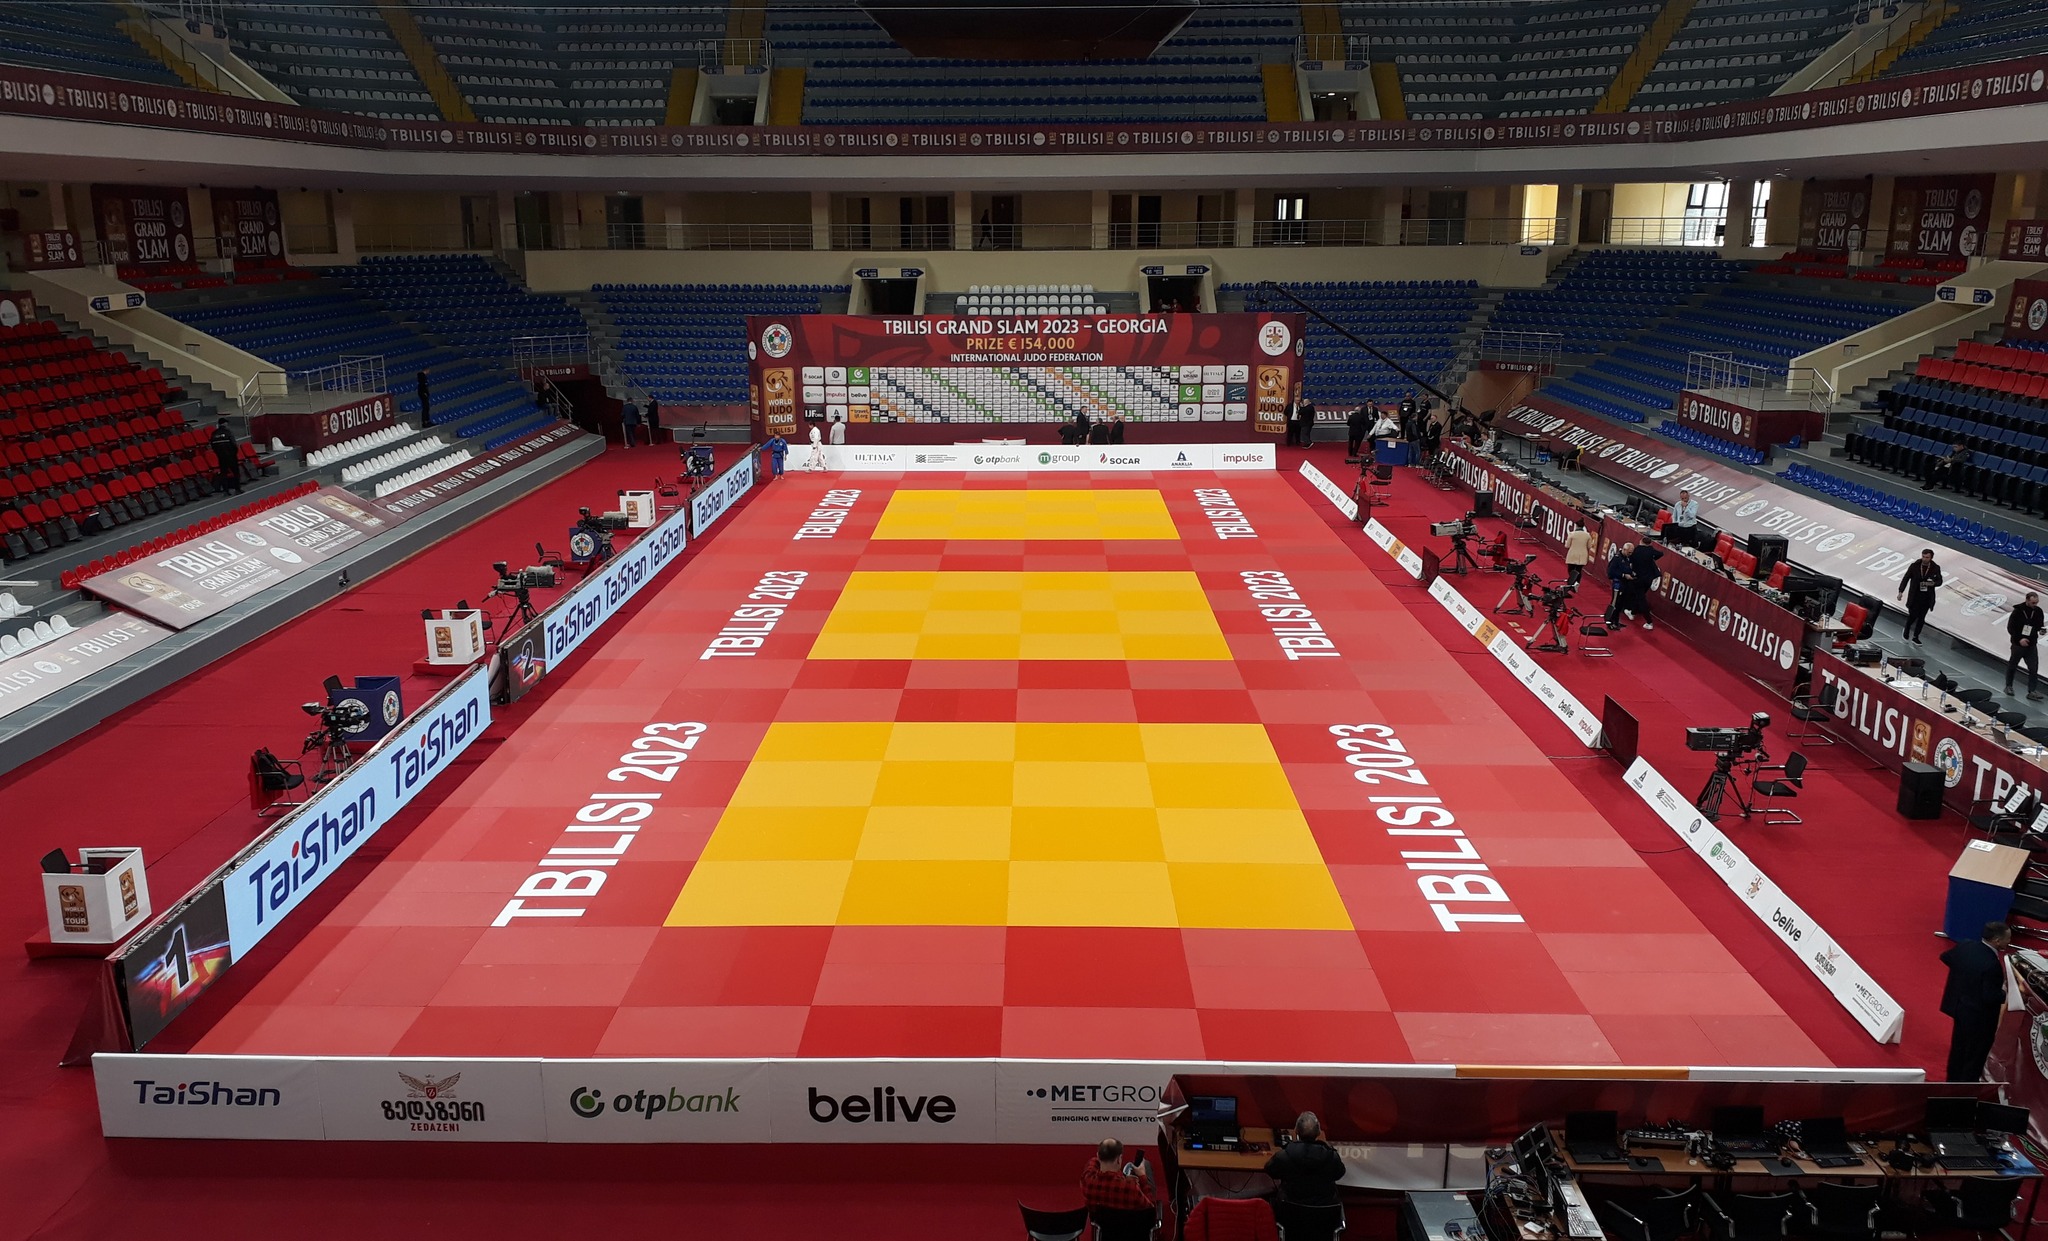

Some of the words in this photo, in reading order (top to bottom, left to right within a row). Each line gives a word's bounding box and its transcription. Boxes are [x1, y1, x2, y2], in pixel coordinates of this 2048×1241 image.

[66, 89, 108, 110] TBILISI
[130, 95, 168, 115] TBILISI
[186, 102, 218, 120] TBILISI
[235, 109, 263, 126] TBILISI
[278, 114, 305, 132] TBILISI
[390, 129, 438, 142] TBILISI
[467, 130, 511, 144] TBILISI
[540, 133, 582, 146] TBILISI
[611, 135, 657, 146] TBILISI
[686, 134, 734, 146] TBILISI
[764, 134, 810, 146] TBILISI
[838, 134, 884, 146] TBILISI
[912, 134, 957, 146] TBILISI
[986, 133, 1031, 145] TBILISI
[1060, 132, 1104, 144] TBILISI
[1132, 132, 1178, 144] TBILISI
[1208, 131, 1254, 143] TBILISI
[1283, 130, 1330, 142] TBILISI
[1359, 129, 1405, 142] TBILISI
[1435, 128, 1482, 140] TBILISI
[1508, 125, 1551, 139] TBILISI
[1578, 122, 1624, 136] TBILISI
[1736, 110, 1761, 126] TBILISI
[1774, 104, 1800, 122] TBILISI
[1818, 98, 1848, 118] TBILISI
[1867, 91, 1901, 111] TBILISI
[1922, 83, 1961, 104] TBILISI
[1986, 73, 2029, 96] TBILISI
[131, 199, 164, 217] TBILISI
[235, 200, 262, 215] TBILISI
[1924, 189, 1958, 207] TBILISI
[134, 222, 166, 237] GRAND
[238, 221, 264, 236] GRAND
[1820, 212, 1847, 227] GRAND
[1921, 212, 1954, 228] GRAND
[241, 236, 267, 254] SLAM
[1817, 228, 1844, 247] SLAM
[1918, 230, 1952, 251] SLAM
[48, 251, 64, 260] SLAM
[136, 239, 170, 259] SLAM
[2022, 244, 2040, 254] SLAM
[882, 320, 932, 334] TBILISI
[936, 320, 993, 334] GRAND
[997, 320, 1038, 334] SLAM
[1042, 320, 1079, 334] 2023
[1096, 319, 1168, 334] GEORGIA
[966, 338, 1004, 350] PRIZE
[1008, 338, 1016, 350] €
[1020, 338, 1075, 351] 154,000
[950, 354, 1021, 362] INTERNATIONAL
[1022, 354, 1047, 362] JUDO
[1049, 353, 1104, 362] FEDERATION
[340, 404, 373, 430] TBILISI
[768, 406, 792, 414] JUDO
[768, 414, 794, 424] TOUR
[1258, 404, 1284, 412] JUDO
[1258, 412, 1284, 421] TOUR
[1699, 402, 1730, 430] TBILISI
[1258, 424, 1284, 432] TBILISI
[855, 454, 894, 462] ULTIMA
[985, 455, 1020, 465] otpbank
[1223, 453, 1263, 464] impulse
[395, 490, 426, 510] TBILISI
[433, 476, 461, 496] TBILISI
[468, 462, 493, 476] TBILISI
[498, 448, 522, 462] TBILISI
[1454, 457, 1481, 490] TBILISI
[1495, 479, 1525, 515] TBILISI
[1518, 406, 1552, 432] TBILISI
[1560, 426, 1604, 453] TBILISI
[1610, 448, 1661, 475] TBILISI
[1673, 473, 1741, 504] TBILISI
[1752, 507, 1830, 545] TBILISI
[697, 490, 724, 527] TaiShan
[726, 467, 750, 501] TaiShan
[819, 488, 862, 507] 2023
[1192, 488, 1236, 507] 2023
[258, 504, 330, 536] TBILISI
[792, 508, 850, 541] TBILISI
[1204, 508, 1258, 540] TBILISI
[294, 526, 328, 547] GRAND
[324, 520, 351, 535] SLAM
[157, 540, 244, 578] TBILISI
[199, 568, 240, 590] GRAND
[234, 558, 267, 576] SLAM
[1240, 570, 1297, 600] 2023
[547, 594, 600, 660] TaiShan
[604, 554, 648, 609] TaiShan
[649, 524, 684, 569] TaiShan
[179, 599, 205, 611] TOUR
[700, 604, 788, 661] TBILISI
[748, 570, 809, 600] 2023
[1669, 578, 1712, 619] TBILISI
[1730, 612, 1780, 661] TBILISI
[68, 628, 135, 656] TBILISI
[1261, 604, 1341, 661] TBILISI
[522, 638, 535, 683] 2
[1558, 698, 1575, 718] belive
[1822, 668, 1908, 757] TBILISI
[1578, 717, 1594, 736] impulse
[1328, 723, 1429, 785] 2023
[249, 786, 376, 926] TaiShan
[390, 696, 478, 800] TaiShan
[489, 793, 662, 927] TBILISI
[607, 722, 707, 782] 2023
[1368, 796, 1526, 932] TBILISI
[1772, 907, 1802, 941] belive
[164, 923, 190, 992] 1
[1857, 985, 1890, 1018] METGROUP
[133, 1080, 280, 1106] TaiShan
[613, 1087, 740, 1120] otpbank
[1051, 1085, 1160, 1102] METGRO
[380, 1100, 485, 1122] ზედაზენი
[808, 1086, 956, 1123] belive
[410, 1123, 459, 1132] ZEDAZENI
